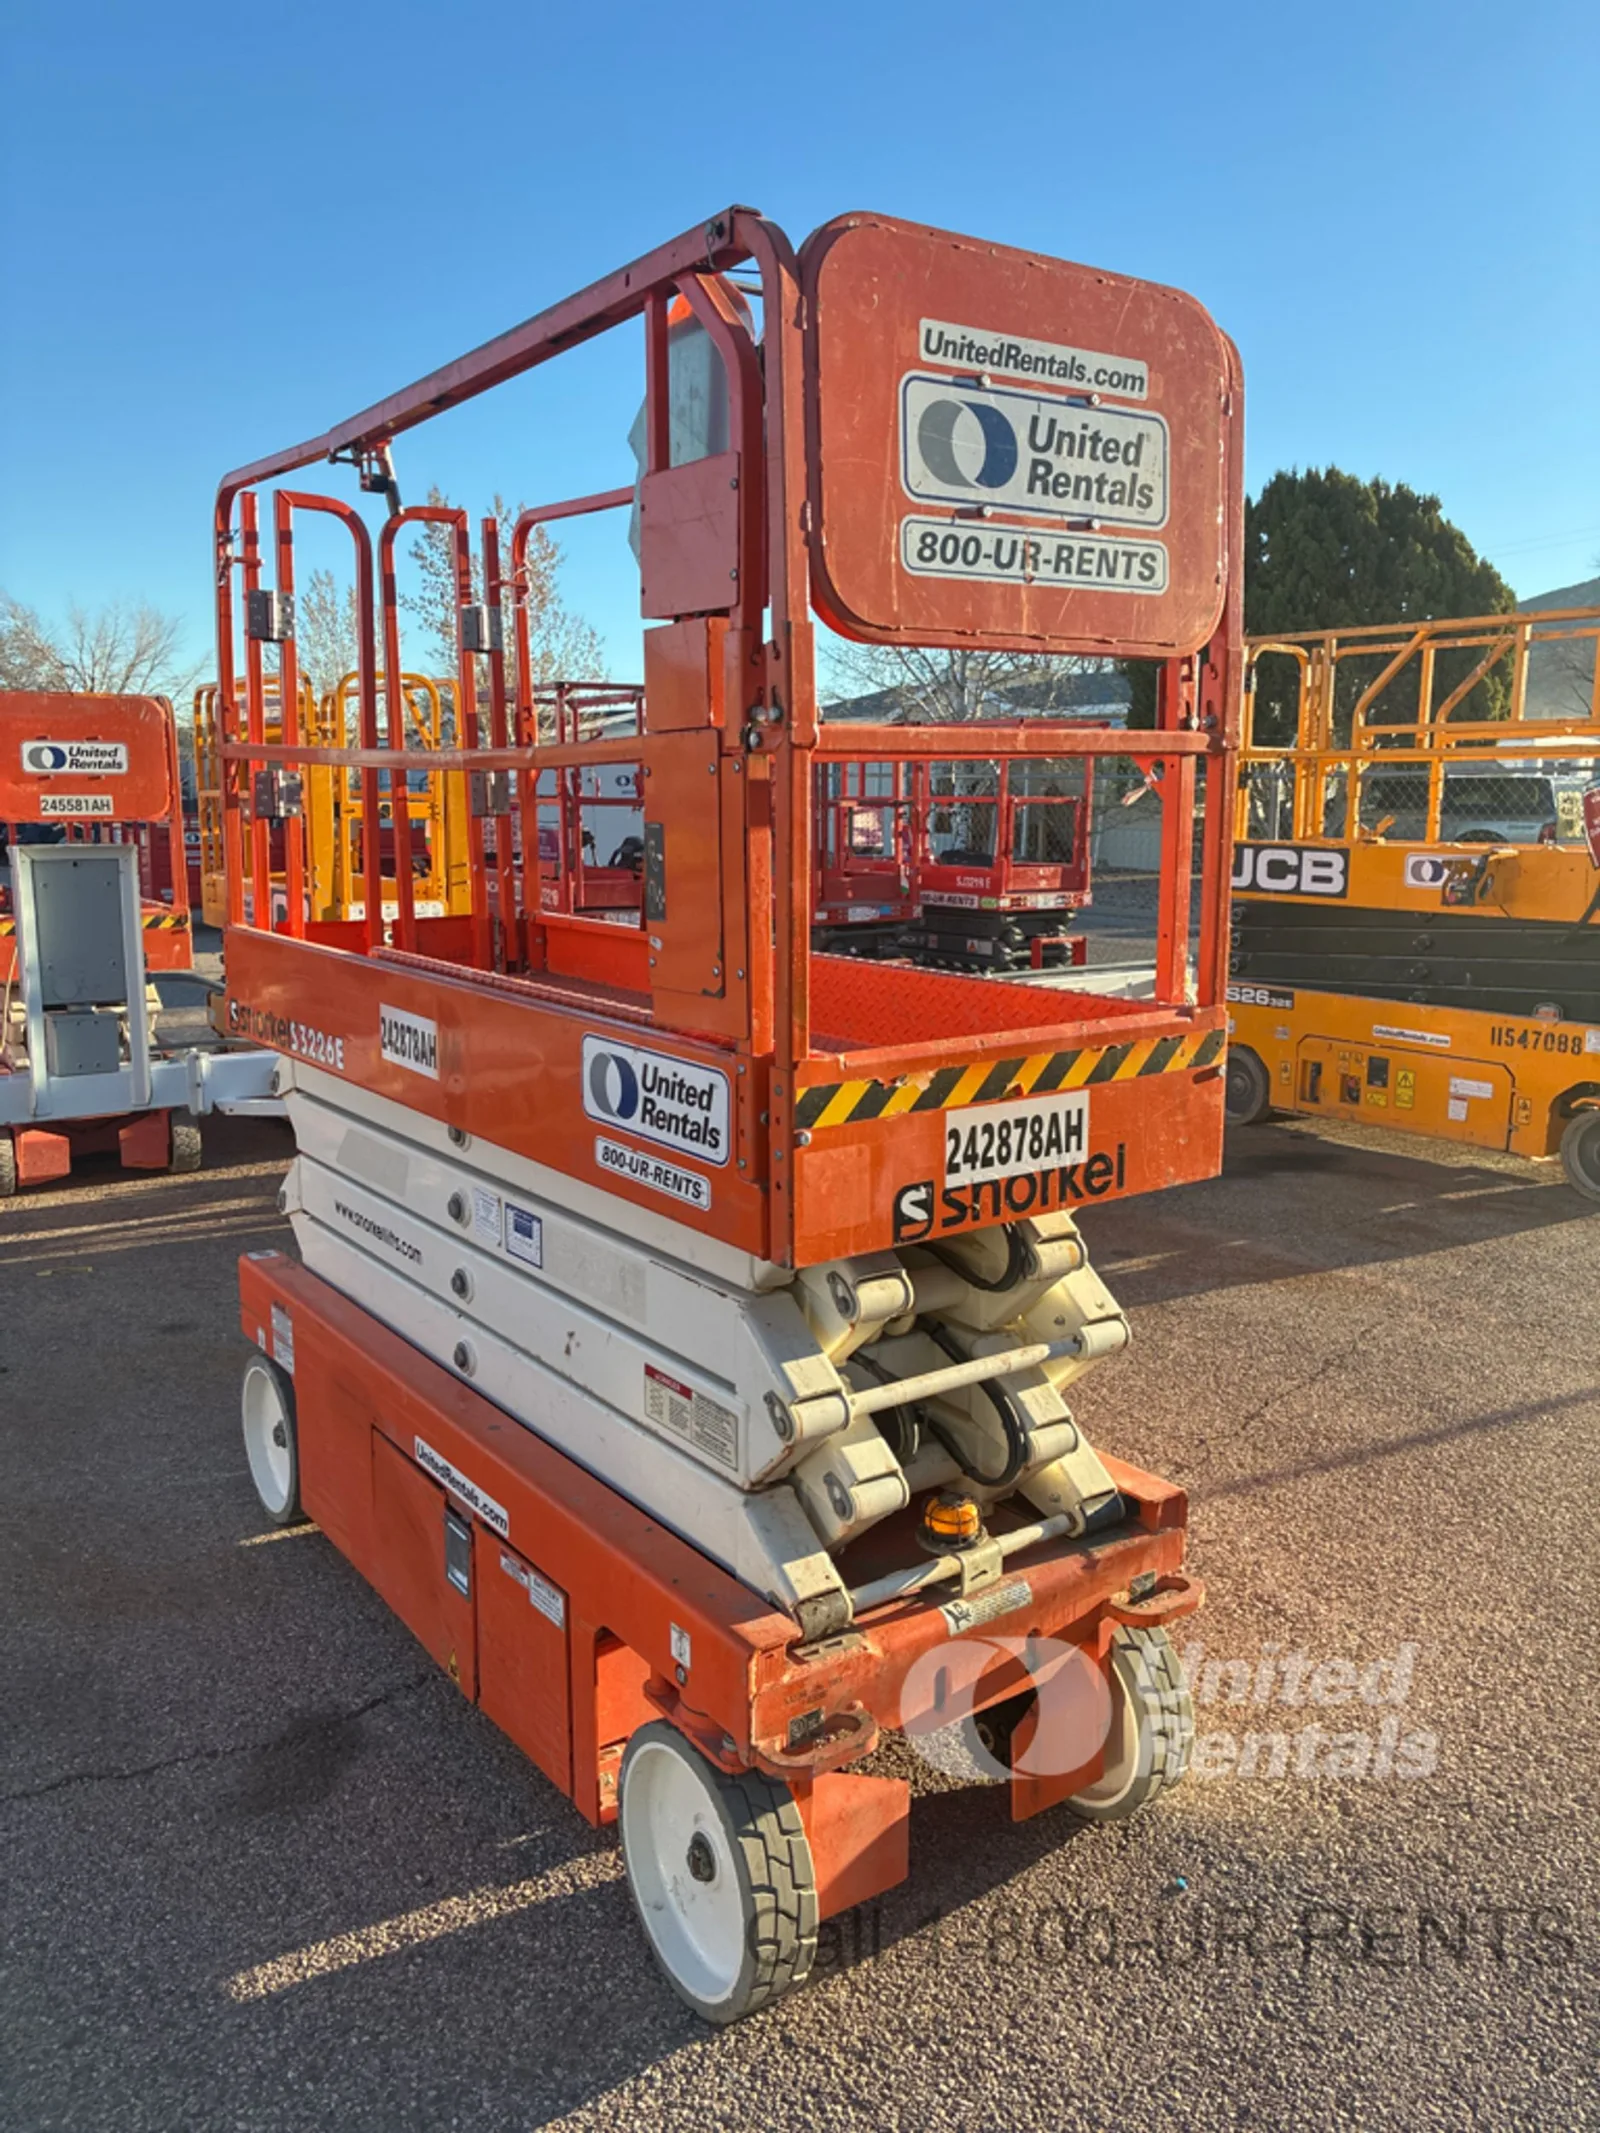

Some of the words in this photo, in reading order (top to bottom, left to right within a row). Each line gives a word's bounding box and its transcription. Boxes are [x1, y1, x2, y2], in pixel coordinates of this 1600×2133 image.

[923, 327, 1145, 393] UnitedRentals.com
[1027, 414, 1144, 468] United
[1026, 458, 1154, 509] Rentals
[916, 531, 1157, 582] 800-UR-RENTS
[68, 746, 119, 758] United
[68, 757, 123, 770] Rentals
[41, 798, 111, 812] 245581AH
[1232, 848, 1345, 893] JCB
[290, 1021, 345, 1070] S3226E
[381, 1016, 437, 1069] 242878AH
[1490, 1026, 1582, 1056] 11547088
[641, 1063, 714, 1112] United
[640, 1095, 721, 1149] Rentals
[946, 1108, 1083, 1176] 242878AH
[601, 1145, 702, 1200] 800-UR-RENTS
